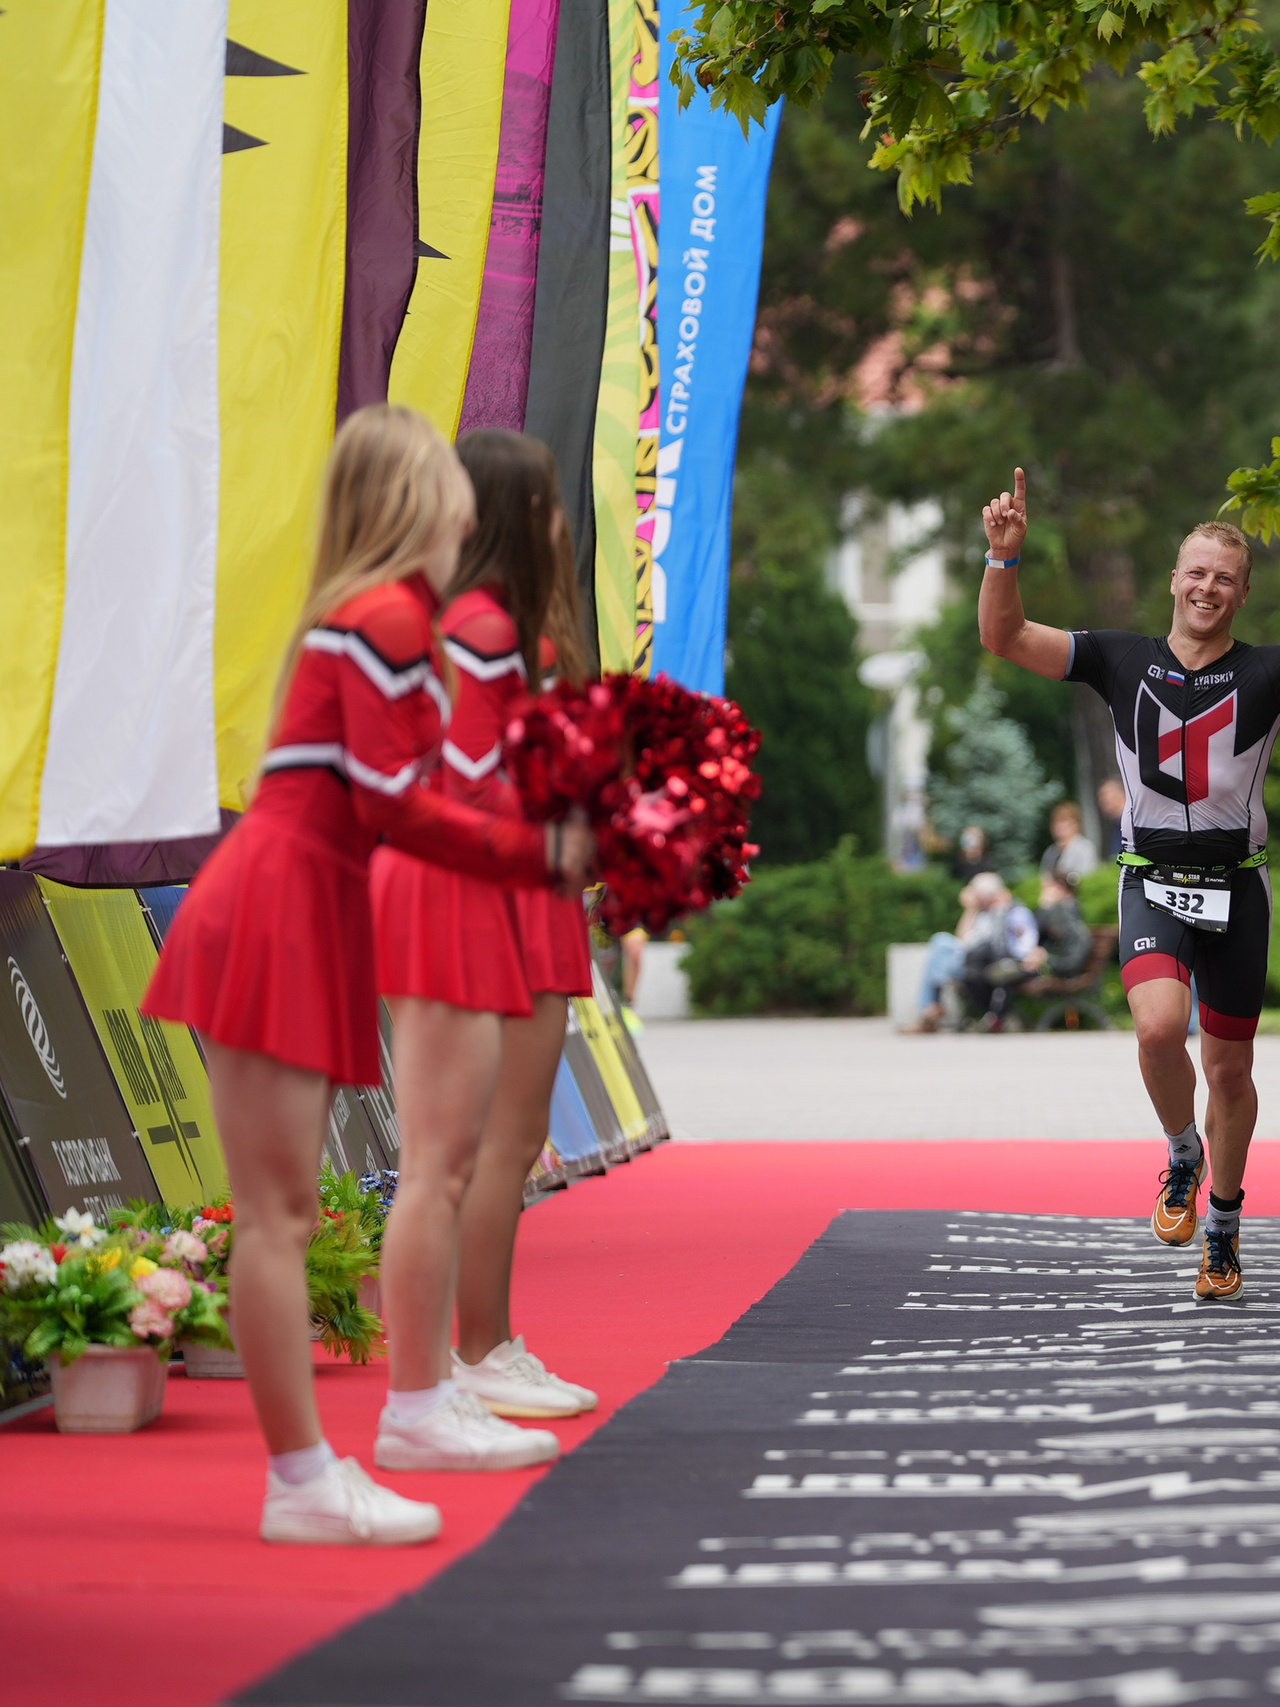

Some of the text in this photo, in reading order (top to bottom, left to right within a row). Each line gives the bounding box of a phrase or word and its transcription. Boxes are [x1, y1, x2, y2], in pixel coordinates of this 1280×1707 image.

[665, 247, 710, 435] СТРАХОВОЙ
[689, 165, 718, 242] ДОМ
[1194, 671, 1234, 686] LYATSKIY
[1188, 873, 1200, 881] STAR
[1165, 890, 1205, 915] 332
